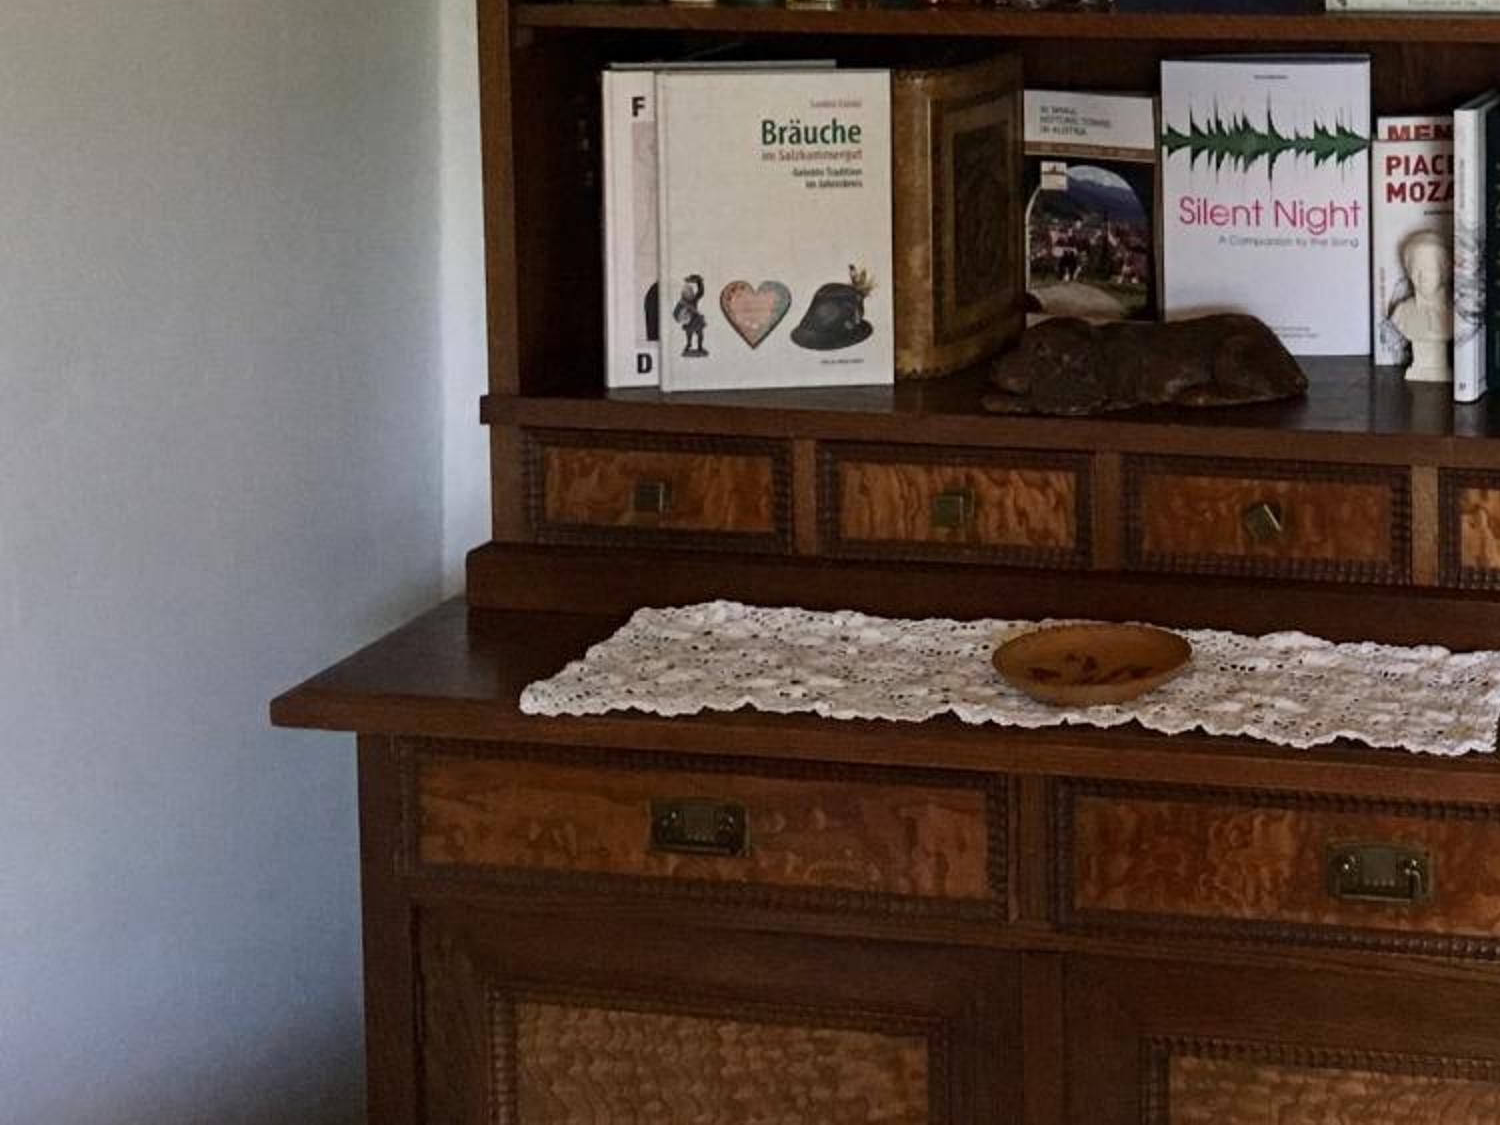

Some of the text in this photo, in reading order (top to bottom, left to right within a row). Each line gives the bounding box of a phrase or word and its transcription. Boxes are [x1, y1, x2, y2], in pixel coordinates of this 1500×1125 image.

[632, 97, 646, 117] F
[761, 118, 862, 146] Bräuche
[779, 148, 863, 163] Salzkammergut
[1179, 195, 1361, 234] Silent Night
[1218, 235, 1227, 245] A
[637, 355, 653, 374] D
